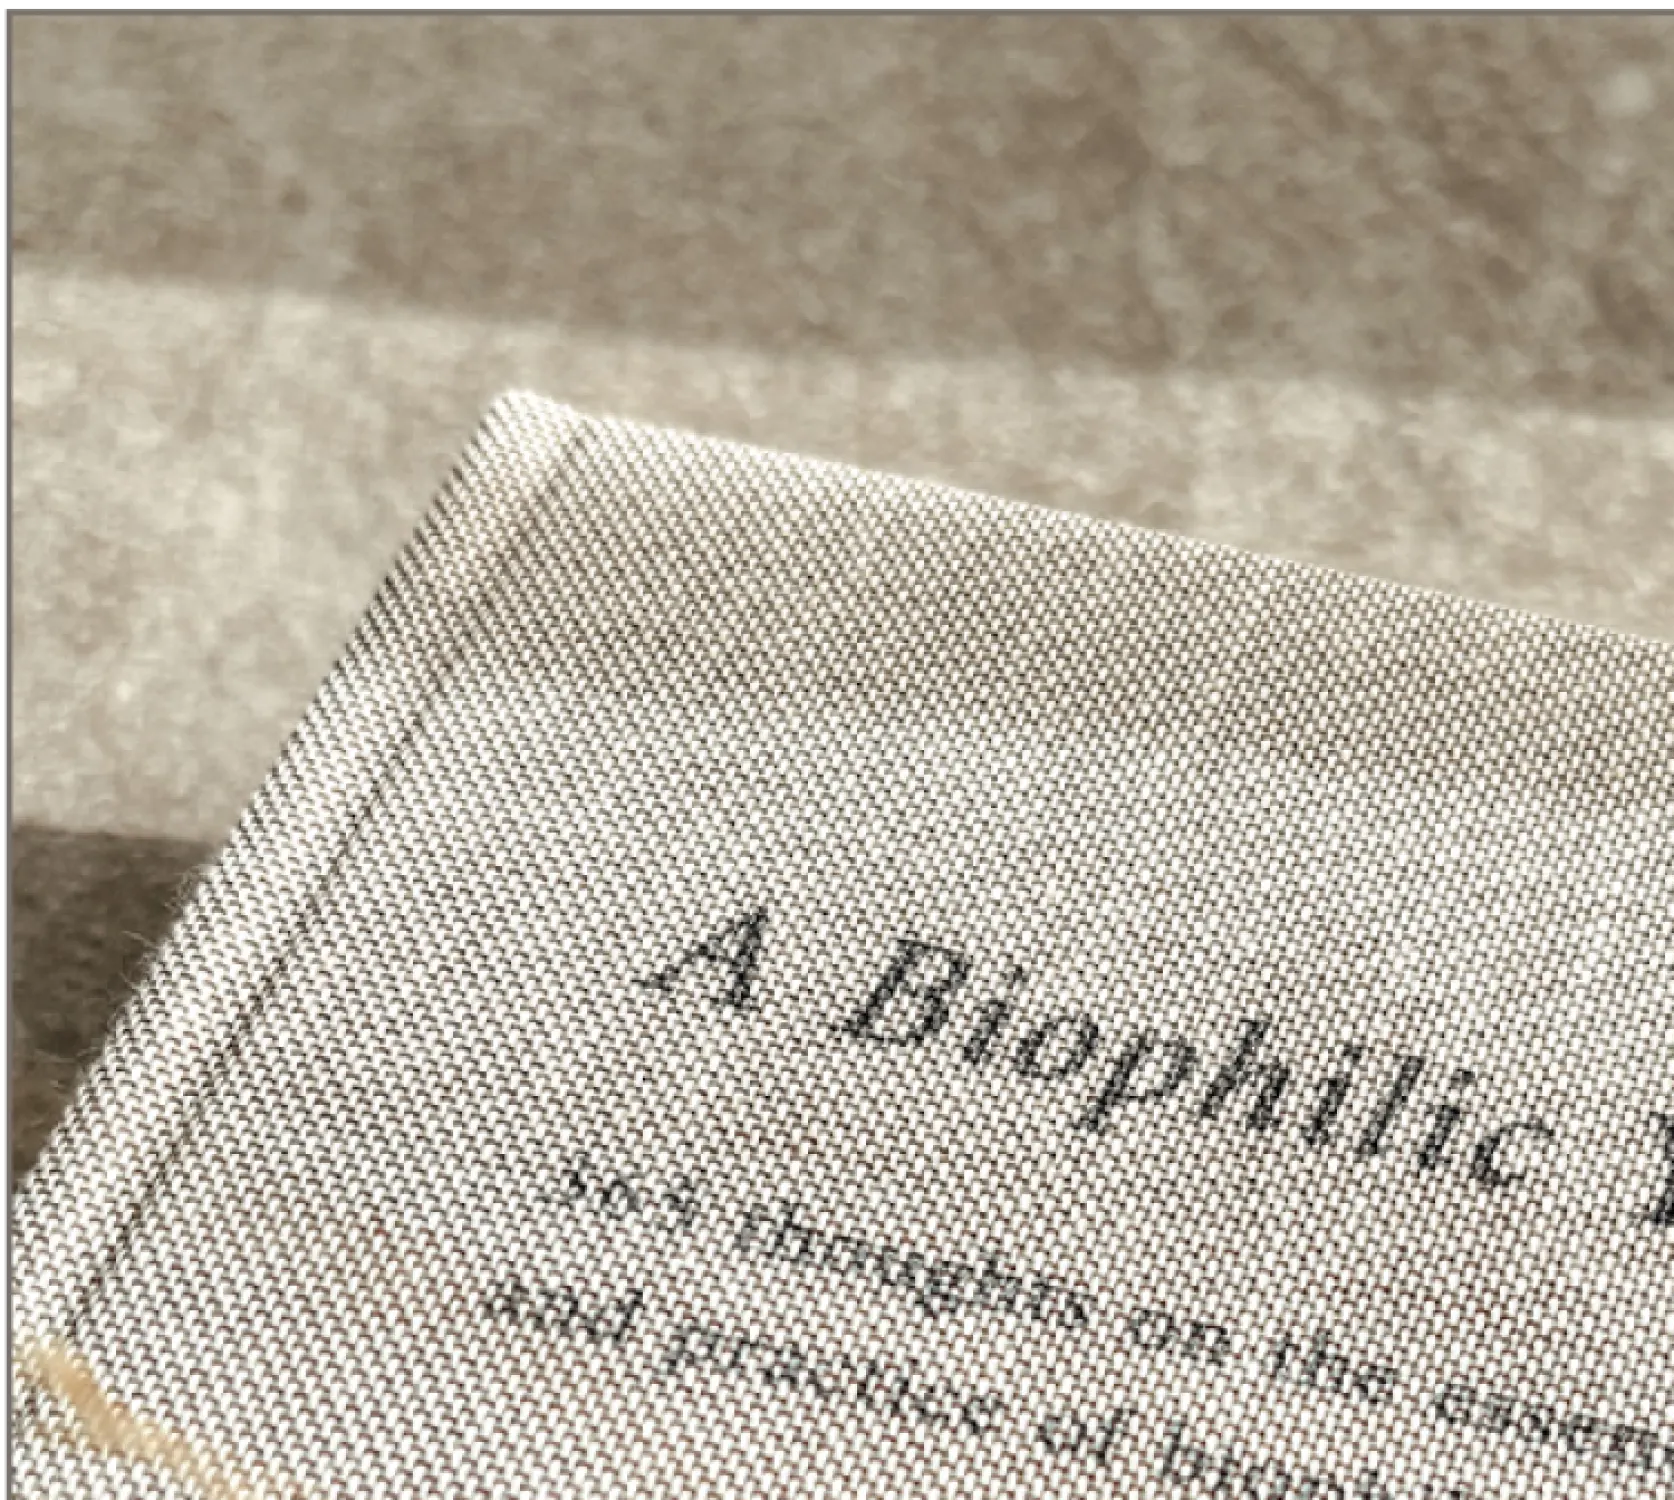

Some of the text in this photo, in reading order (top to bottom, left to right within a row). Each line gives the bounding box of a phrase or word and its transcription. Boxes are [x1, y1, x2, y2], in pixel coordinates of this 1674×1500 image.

[635, 905, 772, 1013] A
[832, 933, 1557, 1192] Biophilic
[480, 1270, 646, 1347] and
[660, 1314, 1006, 1438] practice
[1037, 1402, 1138, 1467] of
[733, 1202, 1096, 1319] thoughts
[1125, 1304, 1232, 1367] on
[1267, 1326, 1399, 1402] the
